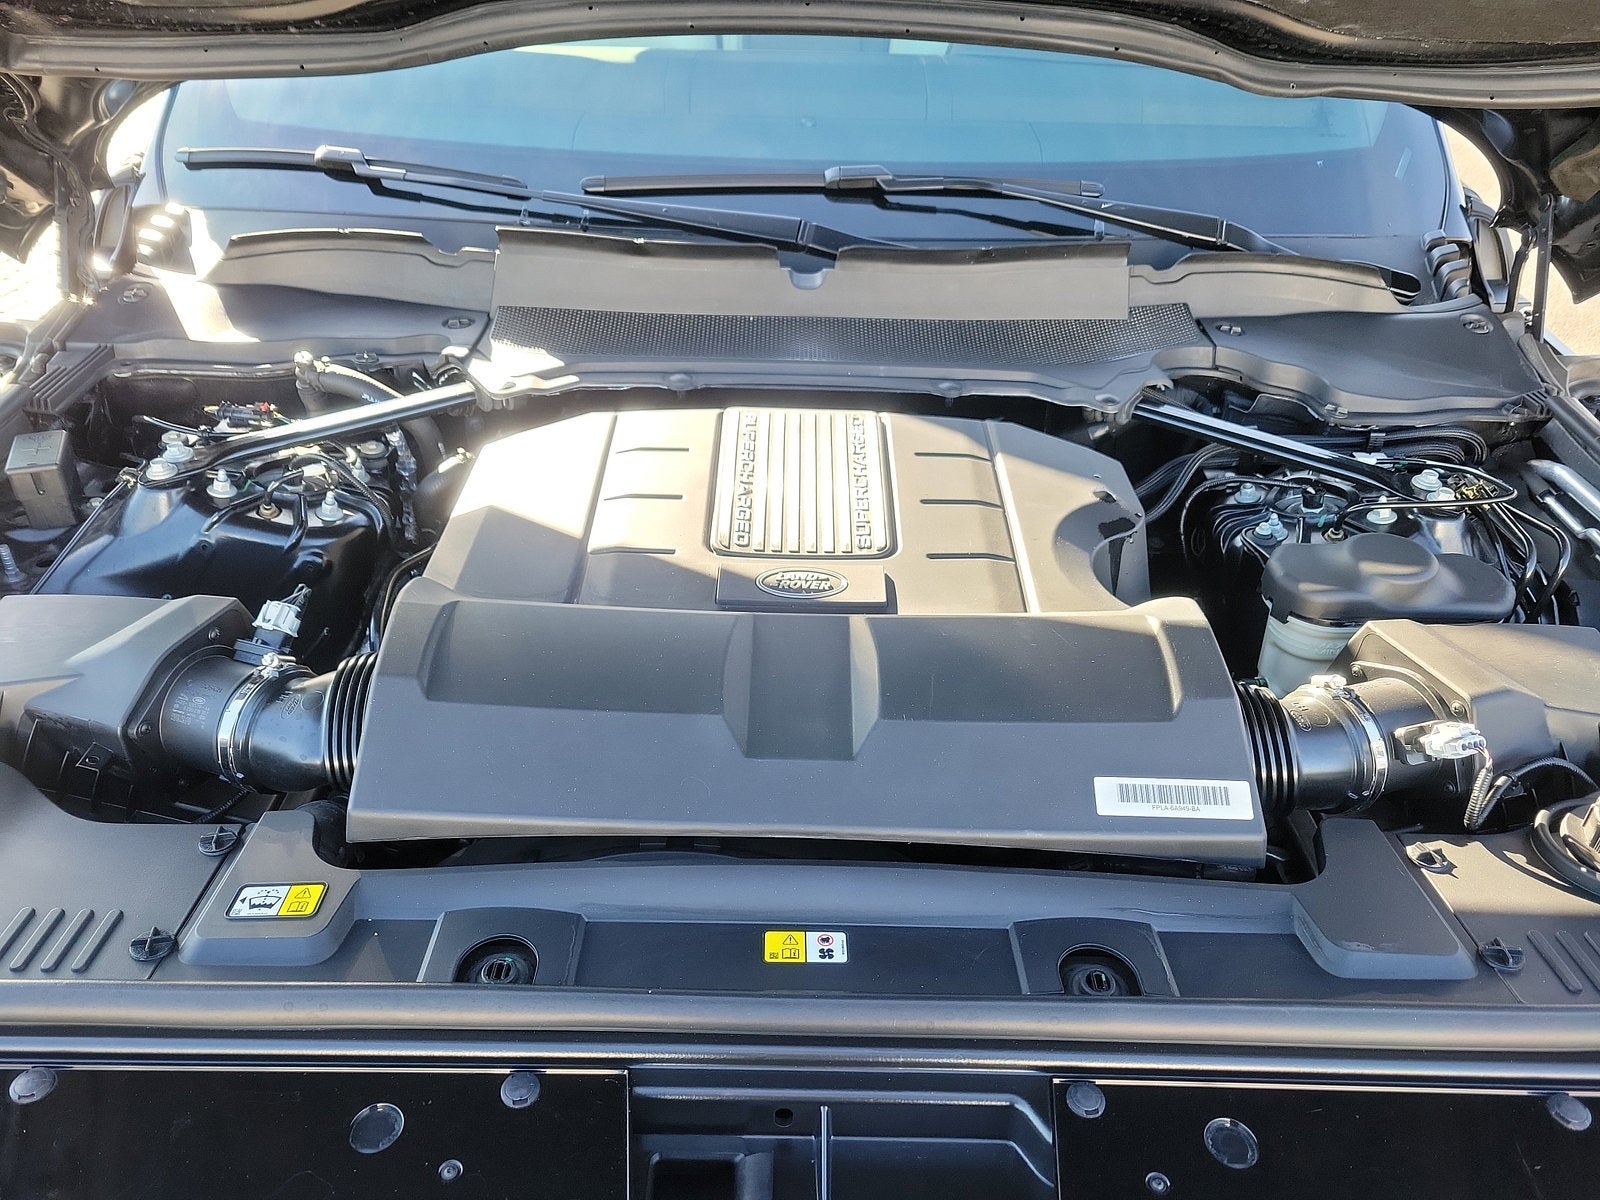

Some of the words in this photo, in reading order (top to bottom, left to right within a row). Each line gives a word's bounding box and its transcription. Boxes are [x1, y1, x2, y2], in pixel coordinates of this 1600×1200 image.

[735, 413, 758, 547] SUPERCHARGED
[852, 416, 872, 550] SUPERCHARGED
[775, 572, 817, 580] LAND
[778, 580, 831, 590] ROVER
